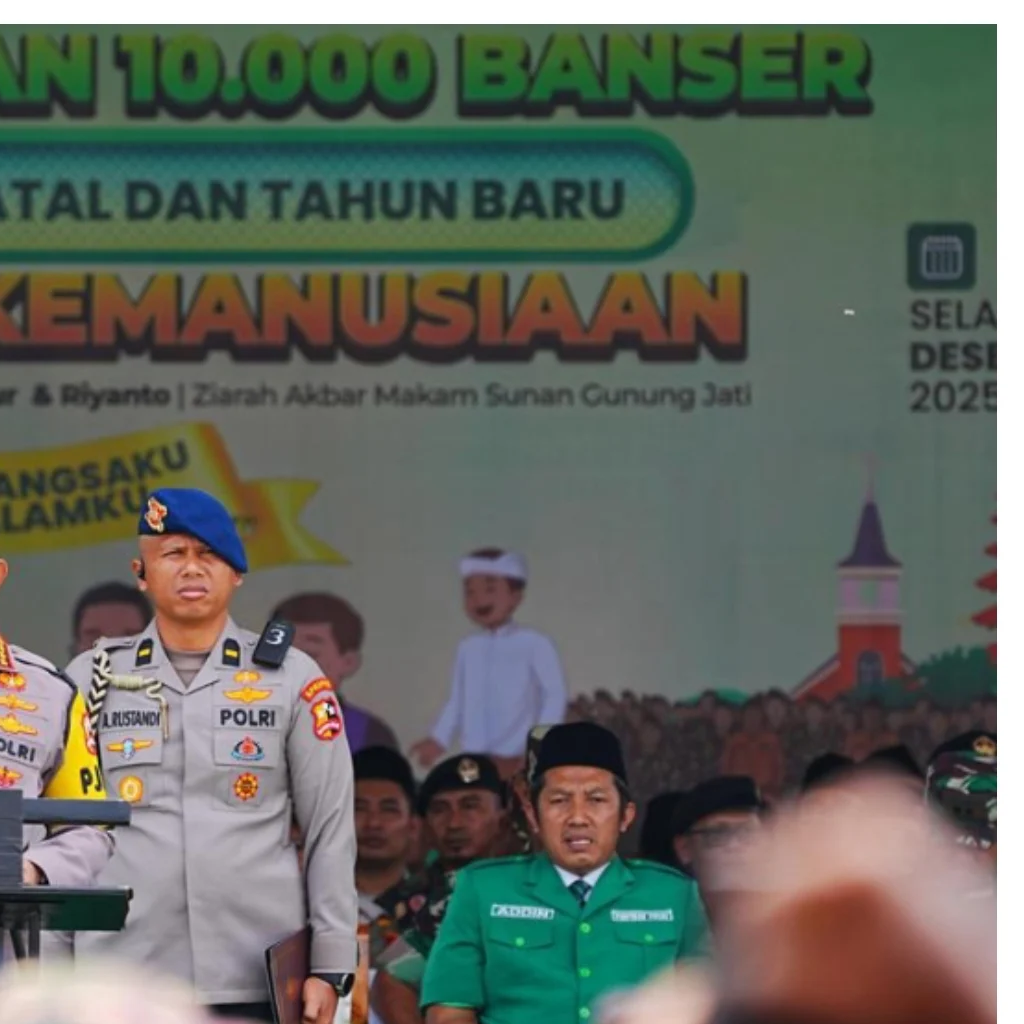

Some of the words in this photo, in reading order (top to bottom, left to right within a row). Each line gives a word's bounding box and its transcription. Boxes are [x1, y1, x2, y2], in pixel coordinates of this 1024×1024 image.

[114, 30, 437, 120] 10.000
[456, 29, 874, 118] BANSER
[123, 178, 257, 222] DAN
[263, 178, 462, 222] TAHUN
[473, 178, 626, 222] BARU
[910, 298, 996, 331] SELA
[31, 384, 53, 406] &
[59, 382, 171, 411] Riyanto
[192, 382, 278, 406] Ziarah
[285, 382, 367, 406] Akbar
[375, 382, 479, 406] Makam
[485, 383, 575, 406] Sunan
[580, 383, 696, 411] Gunung
[703, 383, 752, 406] Jati
[265, 628, 286, 646] 3
[220, 709, 276, 727] POLRI
